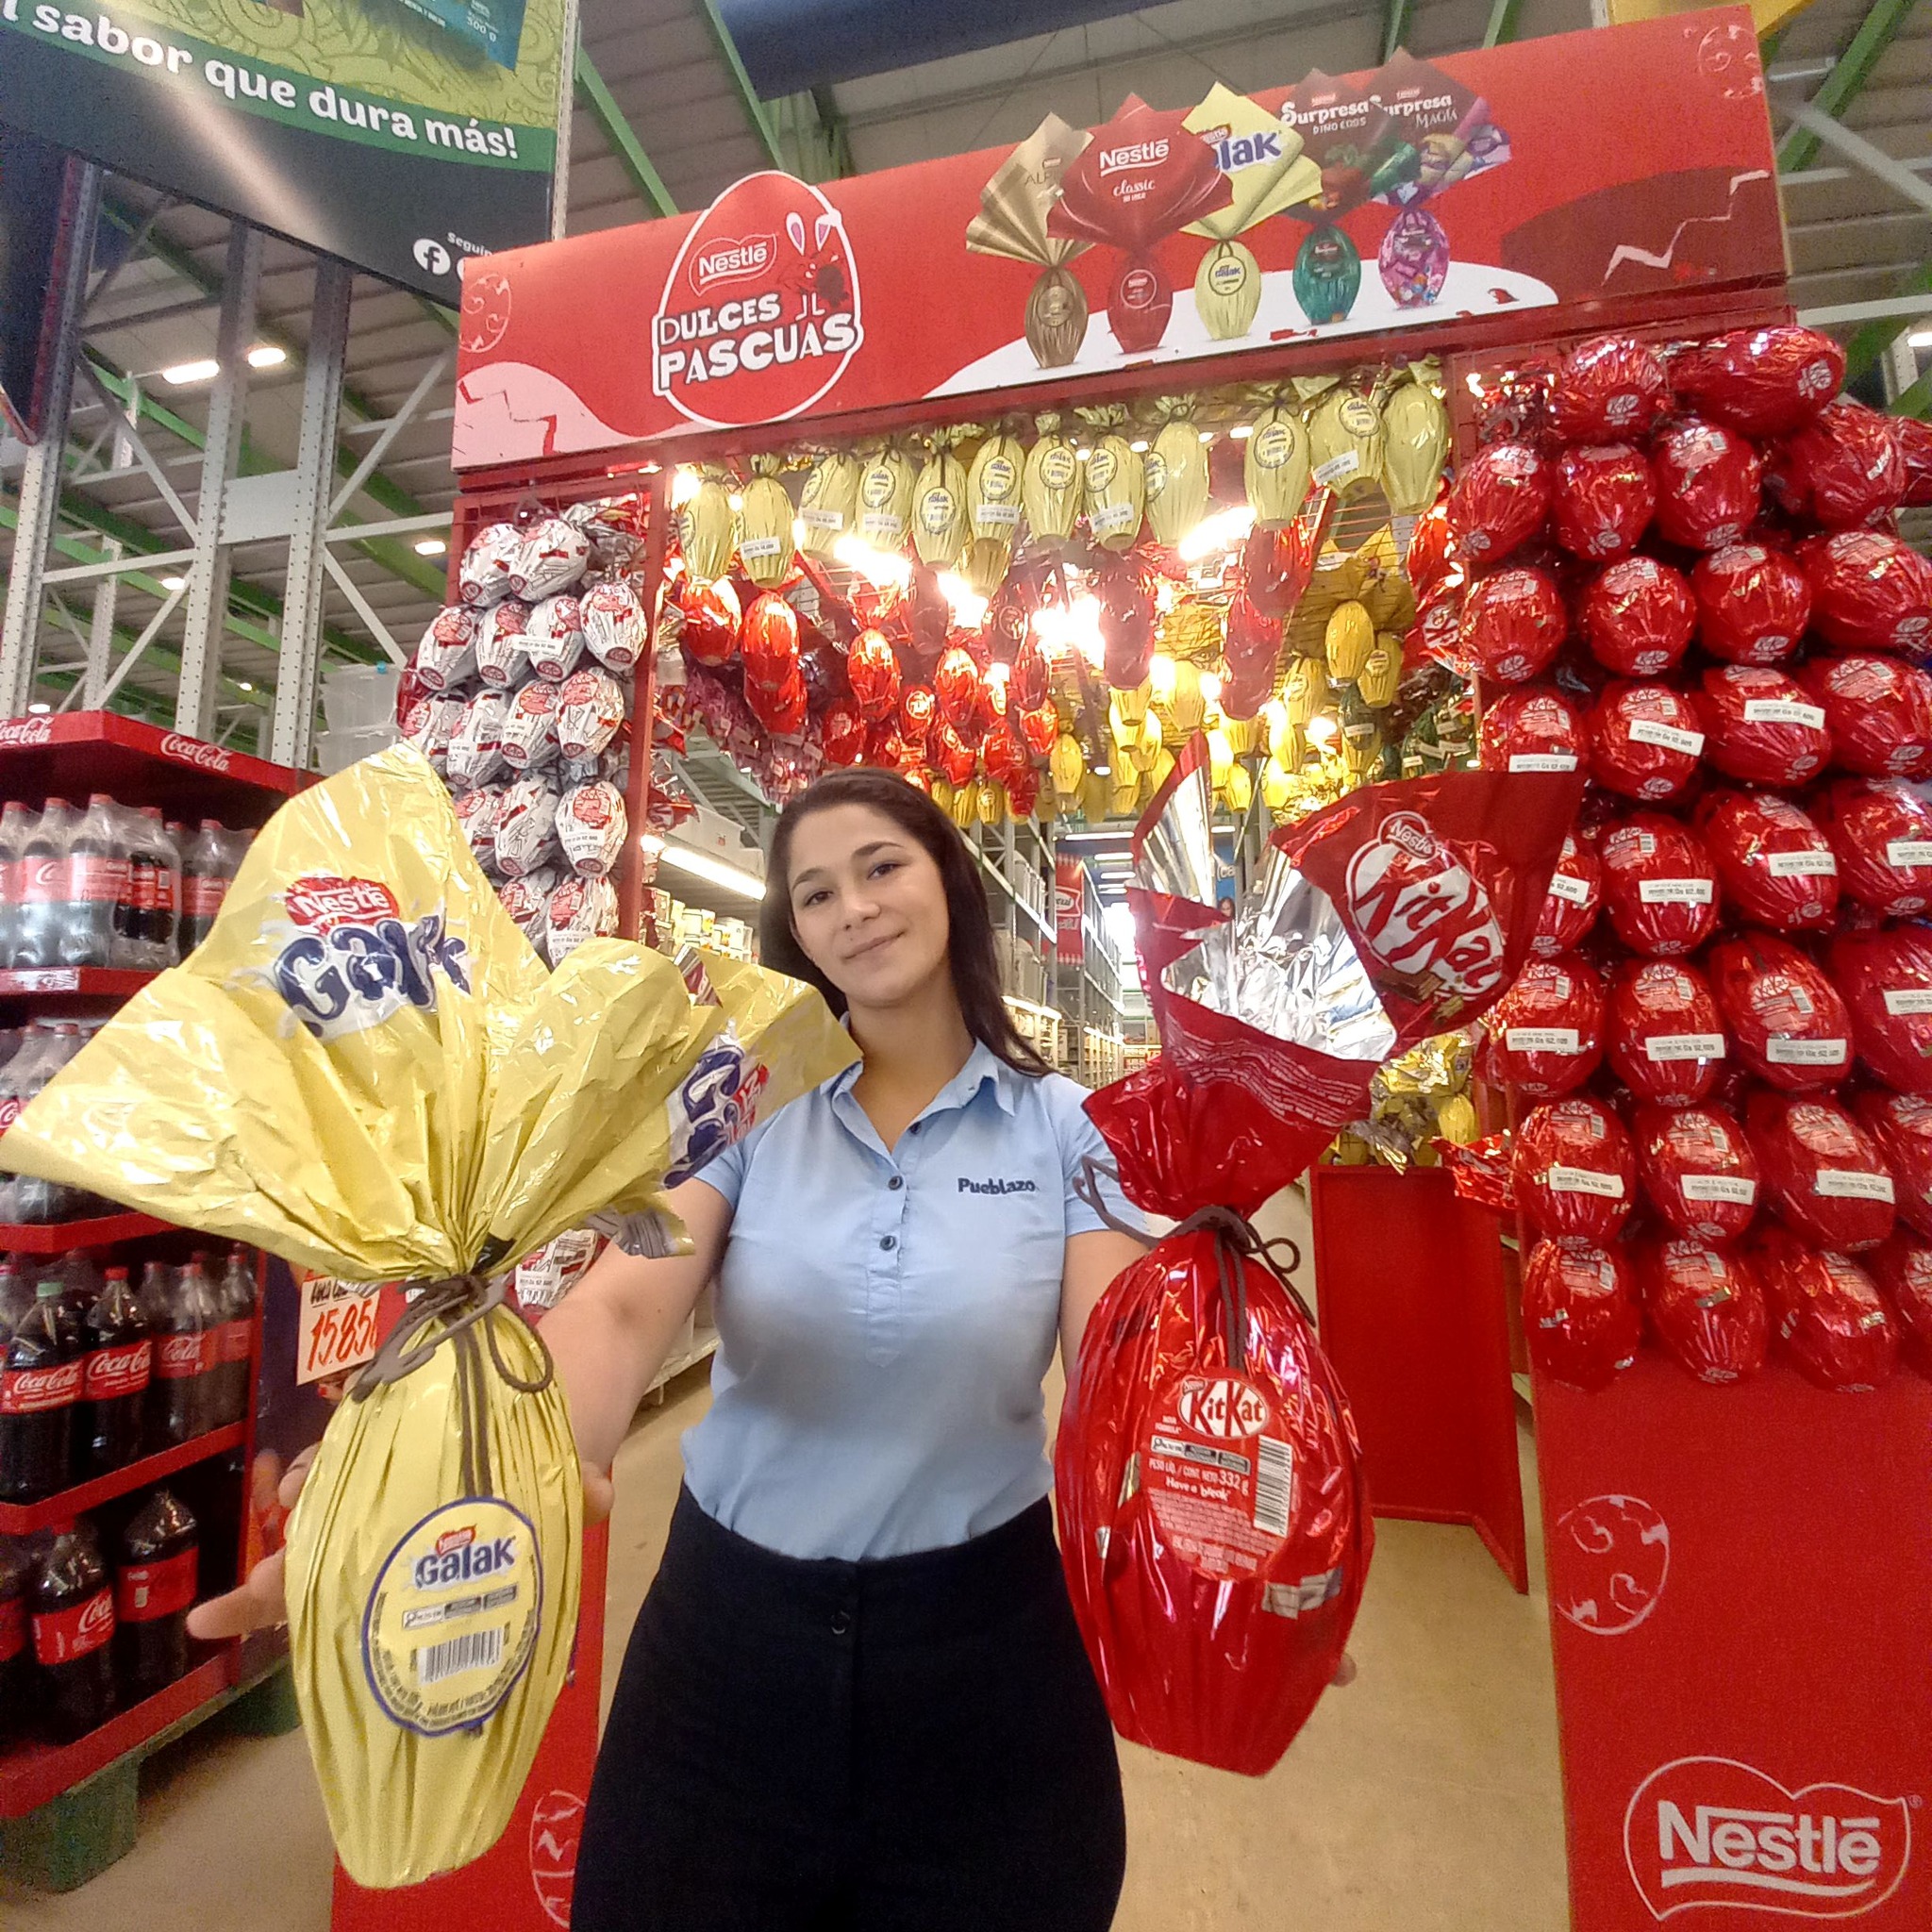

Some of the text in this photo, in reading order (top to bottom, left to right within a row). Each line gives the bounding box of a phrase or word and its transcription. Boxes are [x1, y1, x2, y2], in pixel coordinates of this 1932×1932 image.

[33, 3, 193, 75] sabor
[205, 58, 296, 109] que
[308, 87, 417, 141] dura
[425, 119, 520, 159] más!
[1281, 101, 1369, 127] Surpresa
[1099, 139, 1170, 170] Nestlé
[1112, 178, 1156, 197] classic
[698, 241, 768, 277] Nestlé
[660, 293, 781, 346] DULCES
[660, 313, 856, 389] PASCUAS
[160, 733, 229, 772] Coca-Cola
[1390, 819, 1437, 855] Nestlé
[293, 883, 390, 918] Nestlé
[1352, 854, 1504, 989] KitKat
[958, 1177, 1036, 1195] Pueblazo
[1189, 1379, 1265, 1438] KitKat
[1165, 1476, 1190, 1491] Have
[1190, 1485, 1198, 1494] a
[1219, 1469, 1241, 1491] 332
[415, 1536, 516, 1590] Galak
[1657, 1799, 1881, 1875] Nestlé
